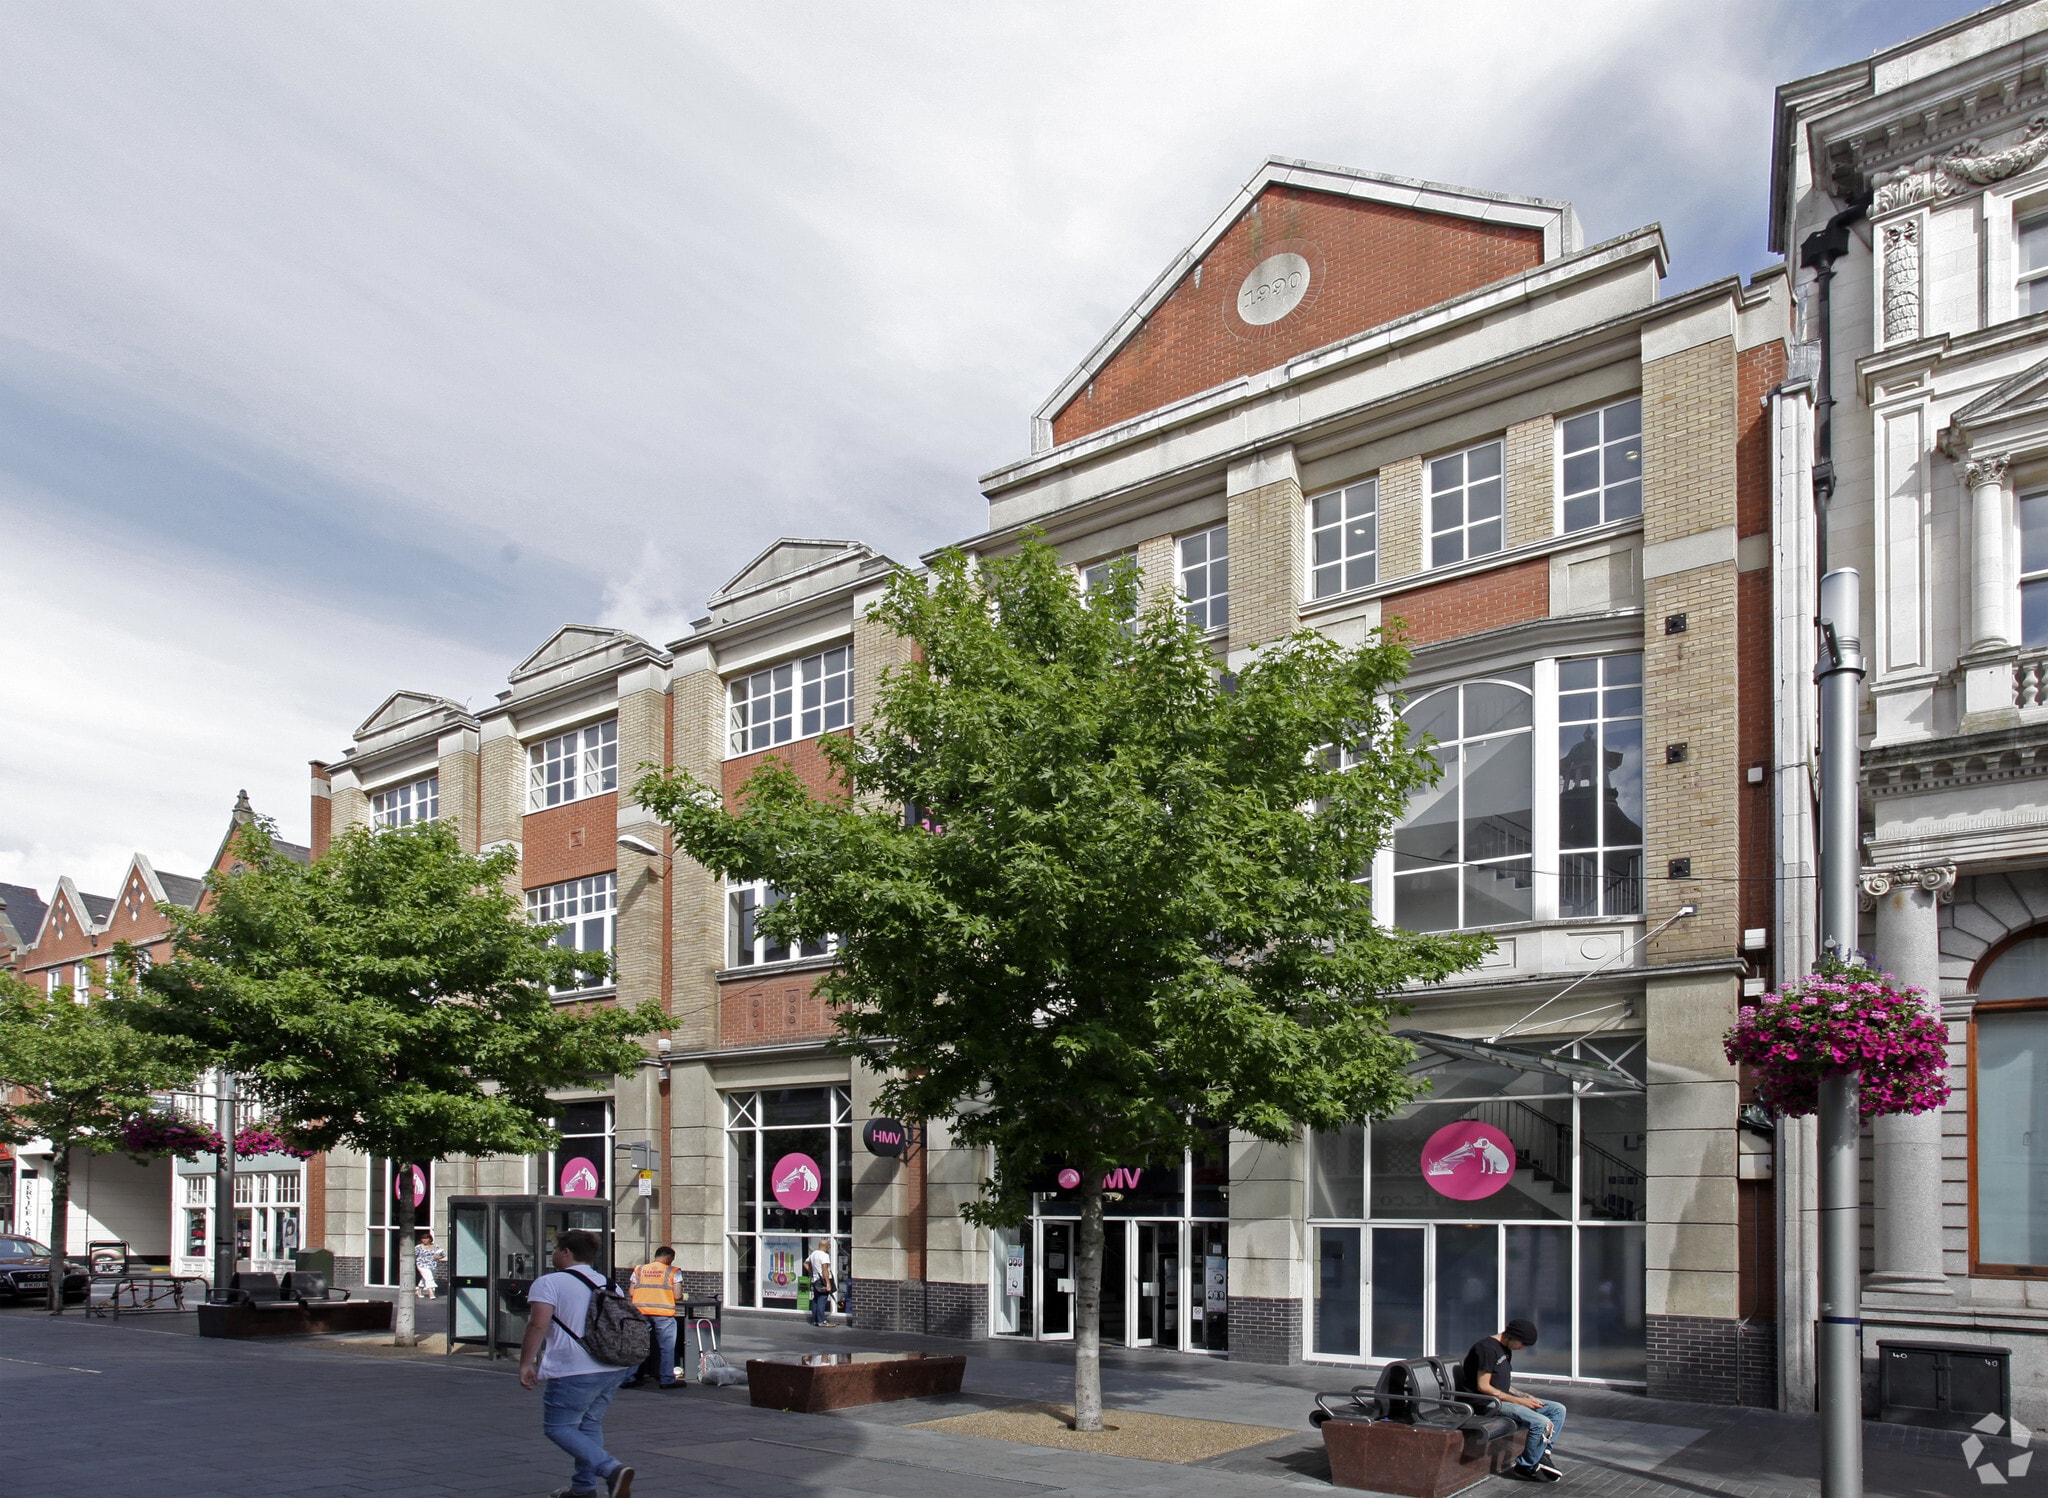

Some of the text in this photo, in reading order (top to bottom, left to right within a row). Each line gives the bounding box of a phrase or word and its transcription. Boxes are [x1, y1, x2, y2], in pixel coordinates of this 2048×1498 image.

[1244, 271, 1303, 308] 1990
[872, 1129, 901, 1145] HMV
[25, 1180, 33, 1216] SERVICE
[1985, 1358, 1999, 1368] 40
